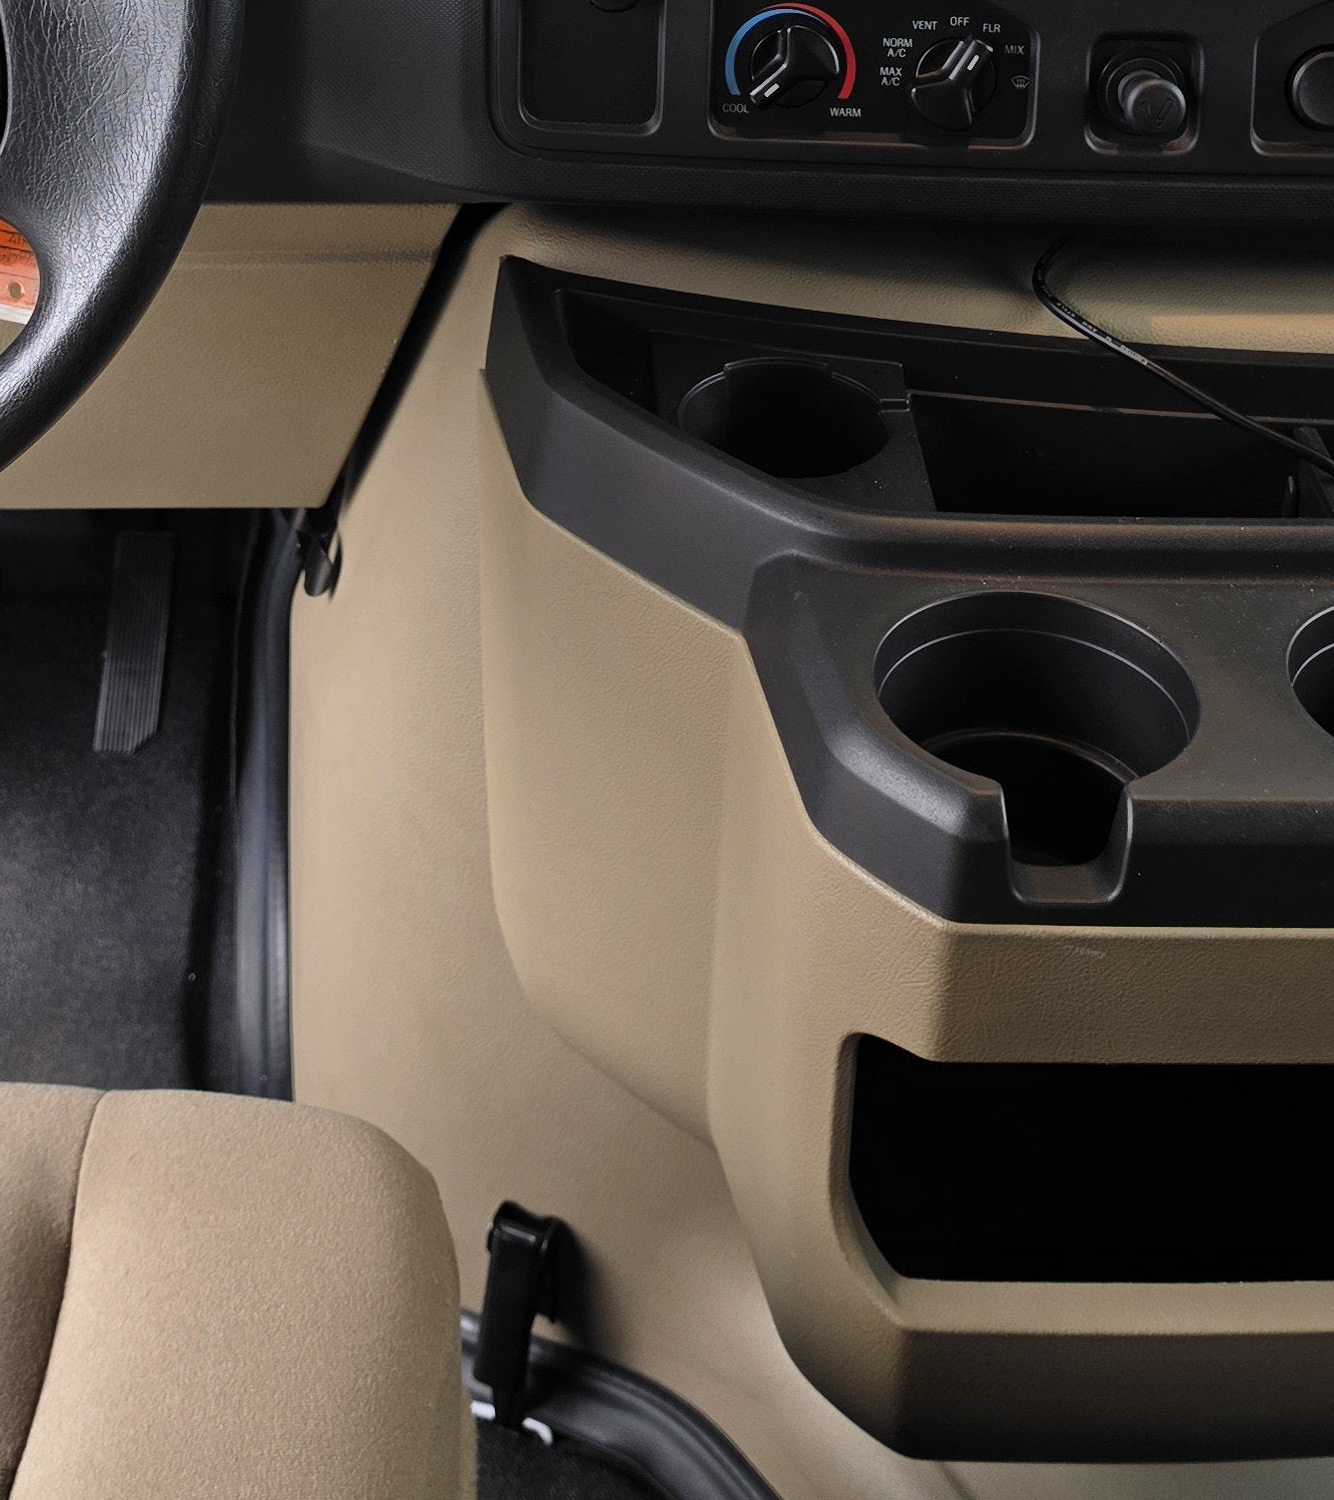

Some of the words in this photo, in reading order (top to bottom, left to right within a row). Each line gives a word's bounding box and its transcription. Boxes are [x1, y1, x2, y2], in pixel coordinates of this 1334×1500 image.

[912, 20, 939, 32] VENT
[949, 16, 970, 28] OFF
[982, 23, 1002, 34] FLR
[882, 38, 913, 49] NORM
[886, 48, 907, 59] A/C
[1004, 45, 1025, 56] MIX
[879, 65, 903, 76] MAX
[880, 76, 901, 87] A/C
[722, 104, 749, 115] COOL
[829, 106, 862, 118] WARM
